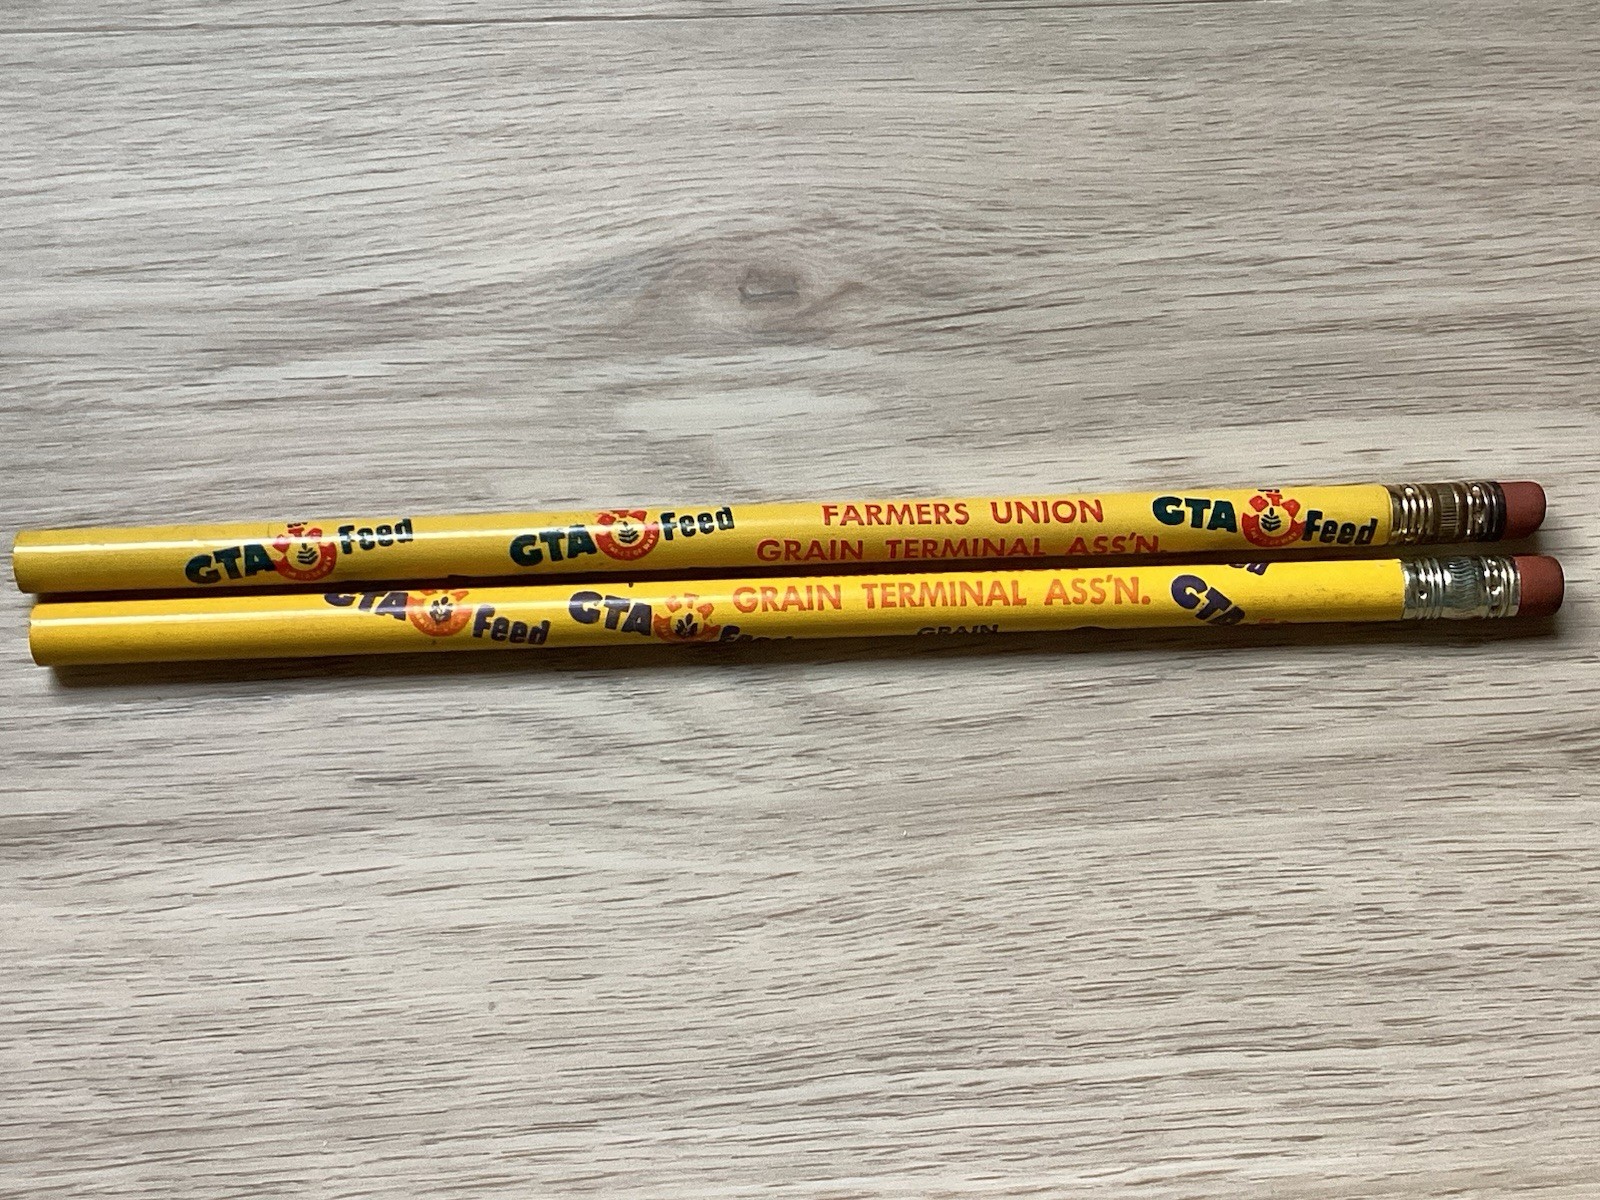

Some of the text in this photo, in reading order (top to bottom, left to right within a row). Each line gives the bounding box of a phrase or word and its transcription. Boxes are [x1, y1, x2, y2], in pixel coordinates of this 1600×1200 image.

[822, 499, 1104, 525] FARMERS UNION
[1152, 496, 1238, 533] GTA
[1302, 510, 1379, 546] Feed
[185, 543, 276, 584] GTA
[338, 518, 413, 554] Feed
[509, 524, 598, 567] GTA
[659, 507, 735, 541] Feed
[756, 538, 864, 562] GRAIN
[885, 536, 1047, 560] TERMINAL
[568, 590, 652, 636] GTA
[732, 574, 1151, 614] GRAIN TERMINAL ASS'N.
[472, 604, 552, 645] Feed
